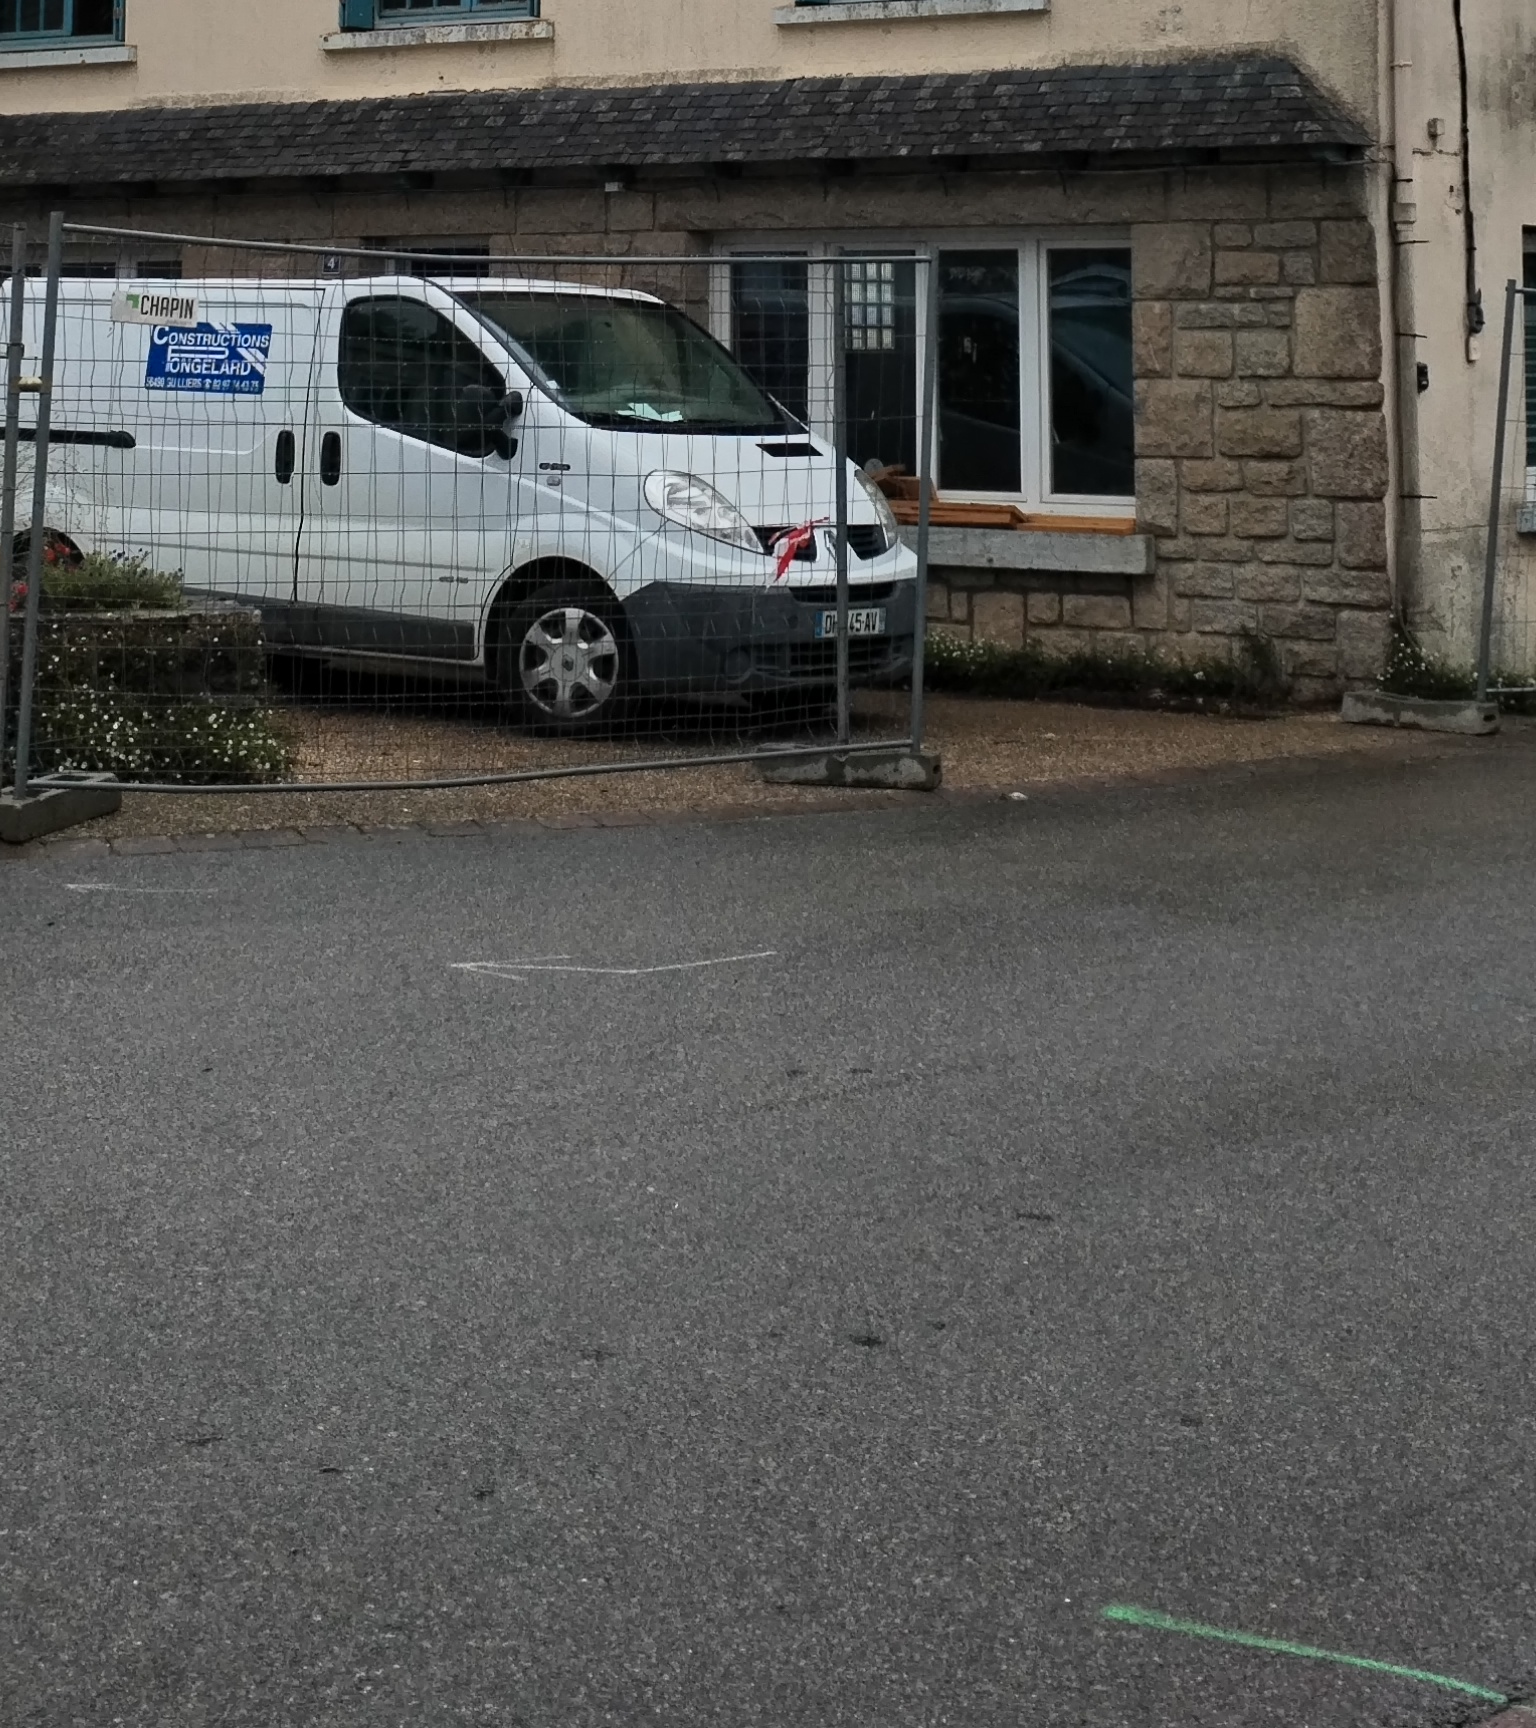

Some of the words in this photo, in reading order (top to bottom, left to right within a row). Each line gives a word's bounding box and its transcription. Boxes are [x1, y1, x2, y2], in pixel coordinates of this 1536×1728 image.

[327, 257, 336, 269] 4
[140, 295, 194, 319] CHAPIN
[153, 325, 269, 348] CONSTRUCTIONS
[825, 612, 877, 634] DH45-AV
